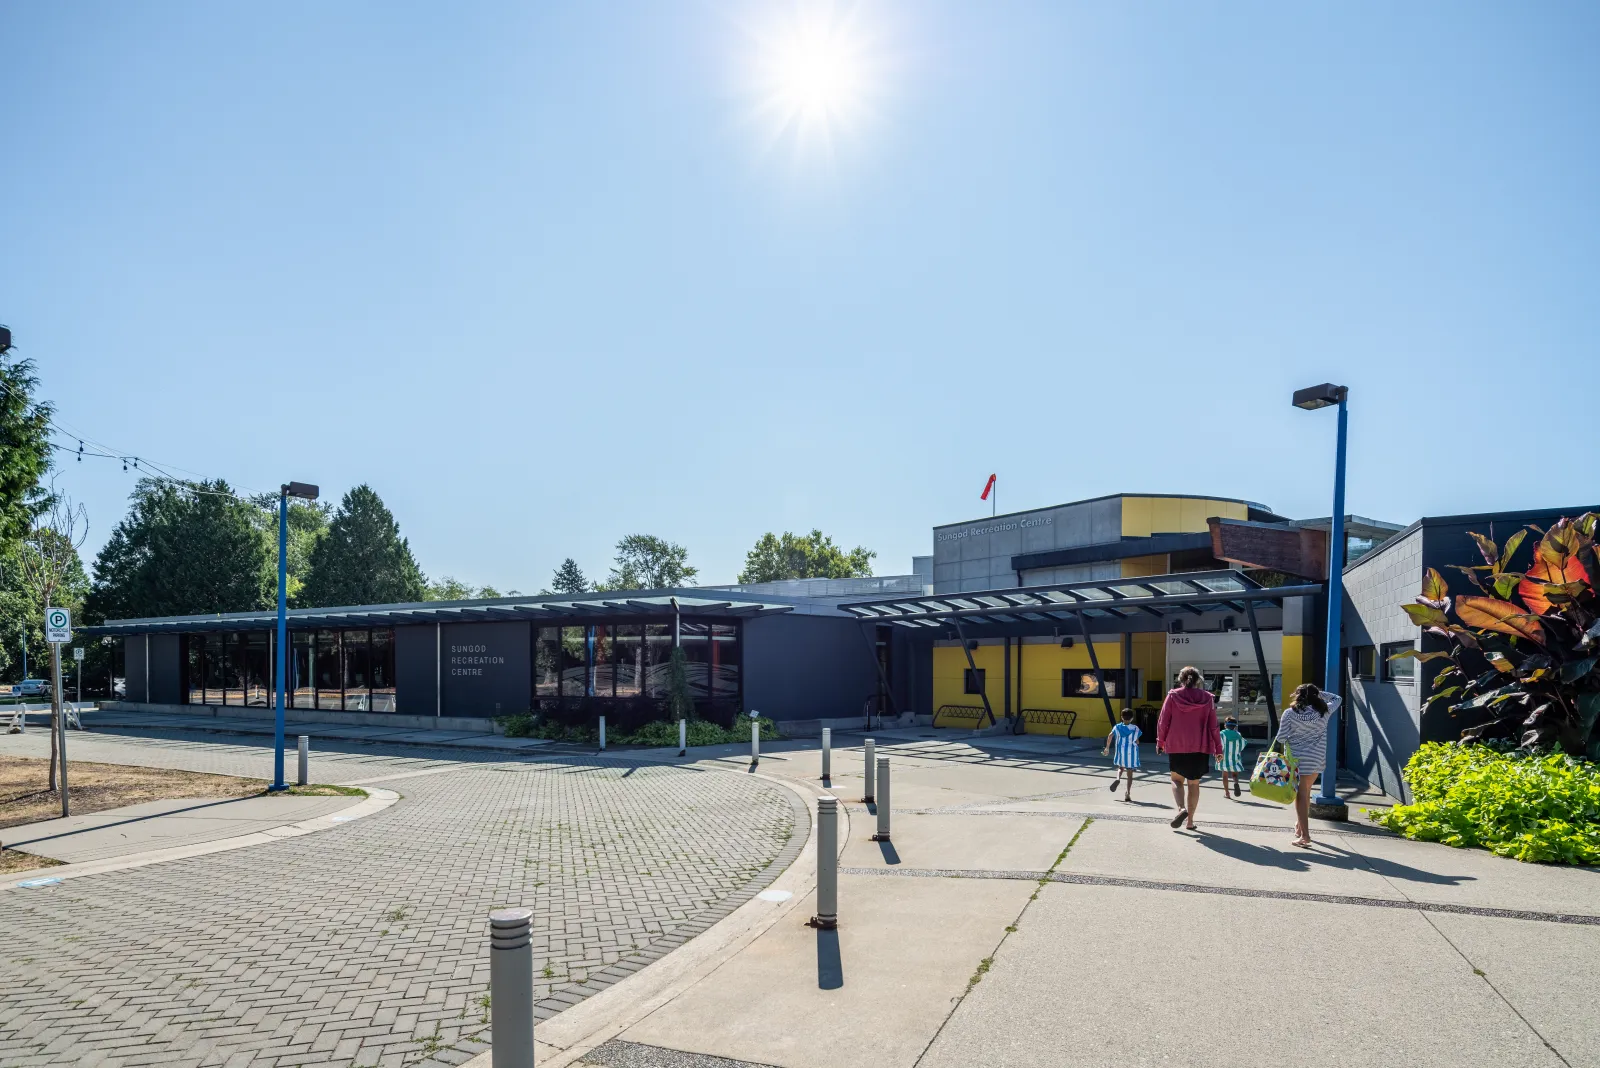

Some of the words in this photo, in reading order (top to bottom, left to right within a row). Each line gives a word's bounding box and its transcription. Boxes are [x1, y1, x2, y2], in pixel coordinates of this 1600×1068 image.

[937, 529, 968, 542] Sungod
[970, 522, 1018, 536] Recreation
[1020, 517, 1052, 528] Centre
